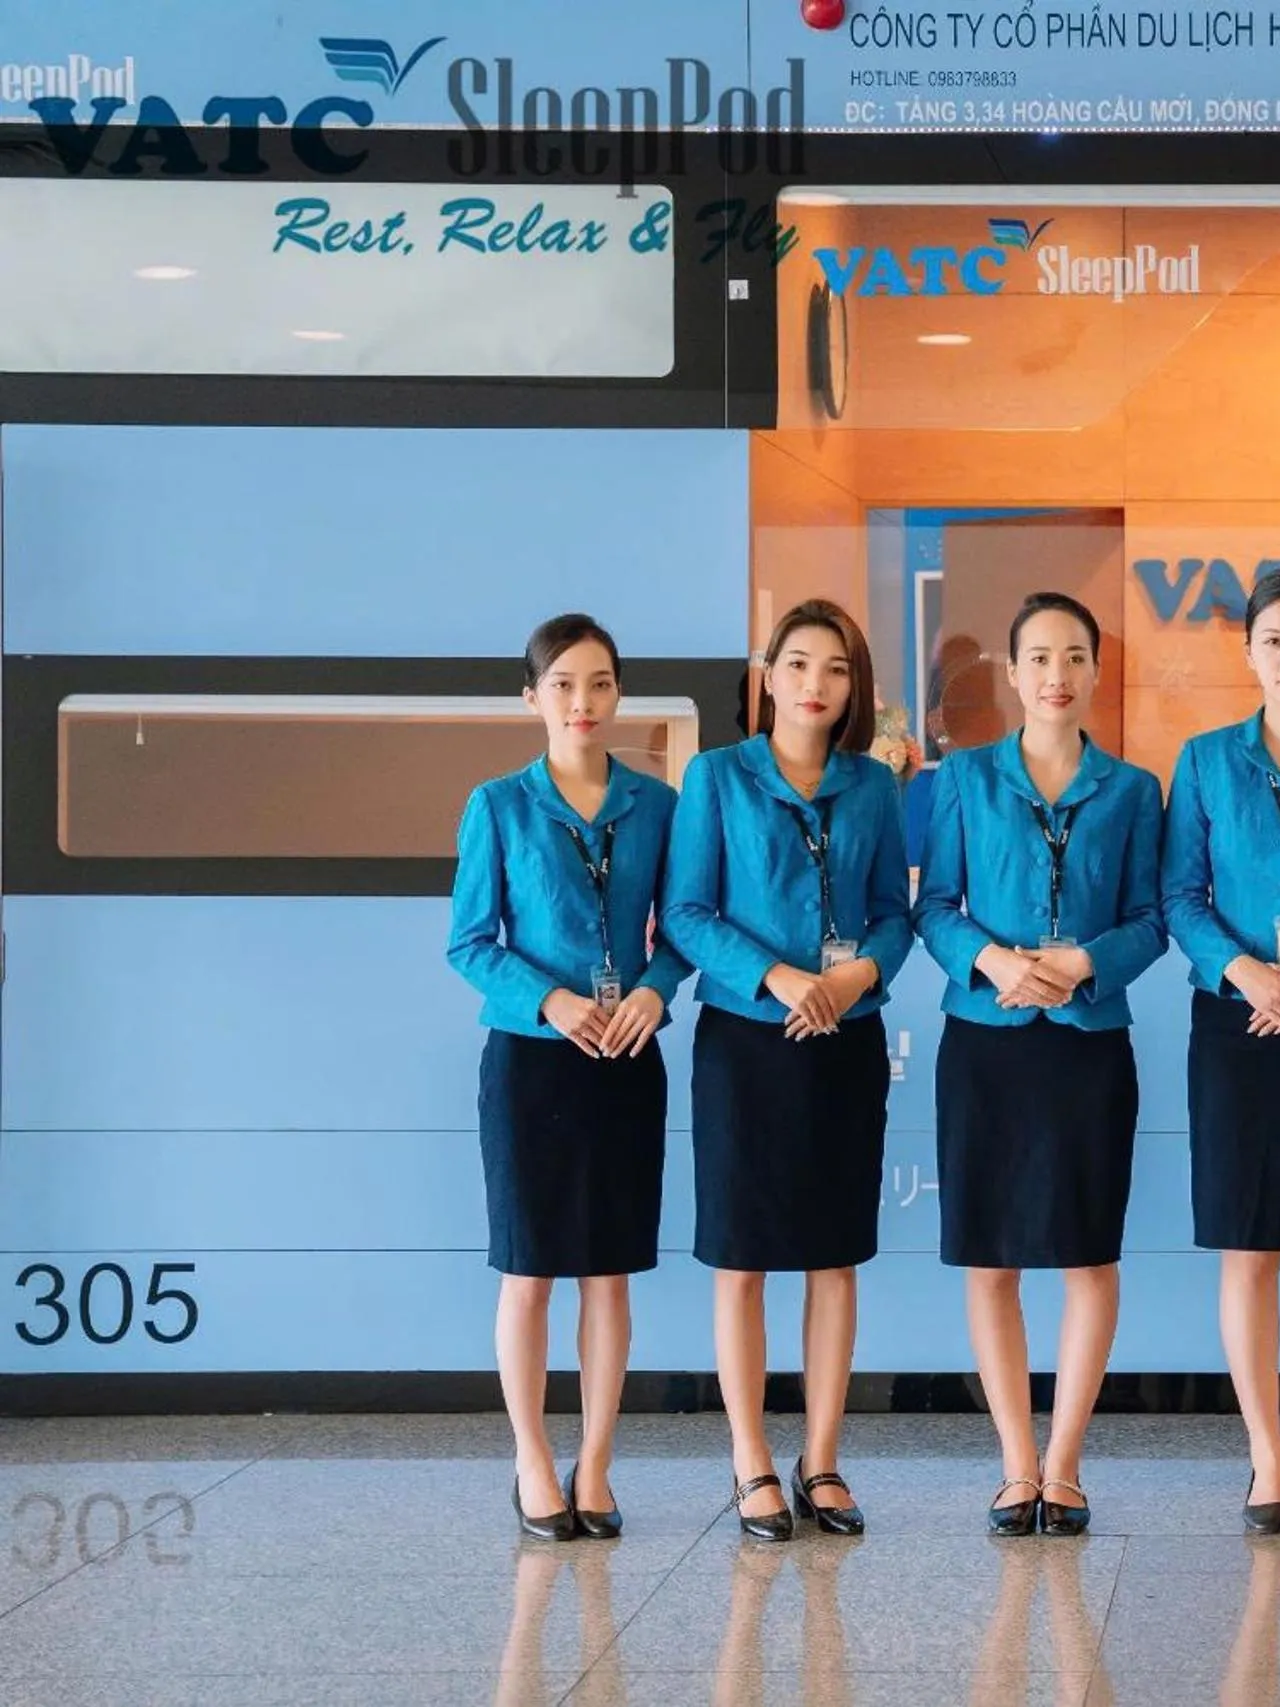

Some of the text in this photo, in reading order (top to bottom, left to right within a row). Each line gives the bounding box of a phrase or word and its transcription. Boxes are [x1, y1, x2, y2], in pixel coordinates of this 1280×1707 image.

[850, 7, 937, 48] CÔNG
[947, 12, 985, 48] TY
[994, 0, 1037, 49] CỔ
[1138, 13, 1177, 48] DU
[1189, 11, 1253, 52] LỊCH
[845, 101, 885, 123] ĐC:
[1013, 93, 1091, 123] HOÀNG
[812, 244, 1201, 303] VATC SleepPod
[15, 1262, 199, 1346] 305
